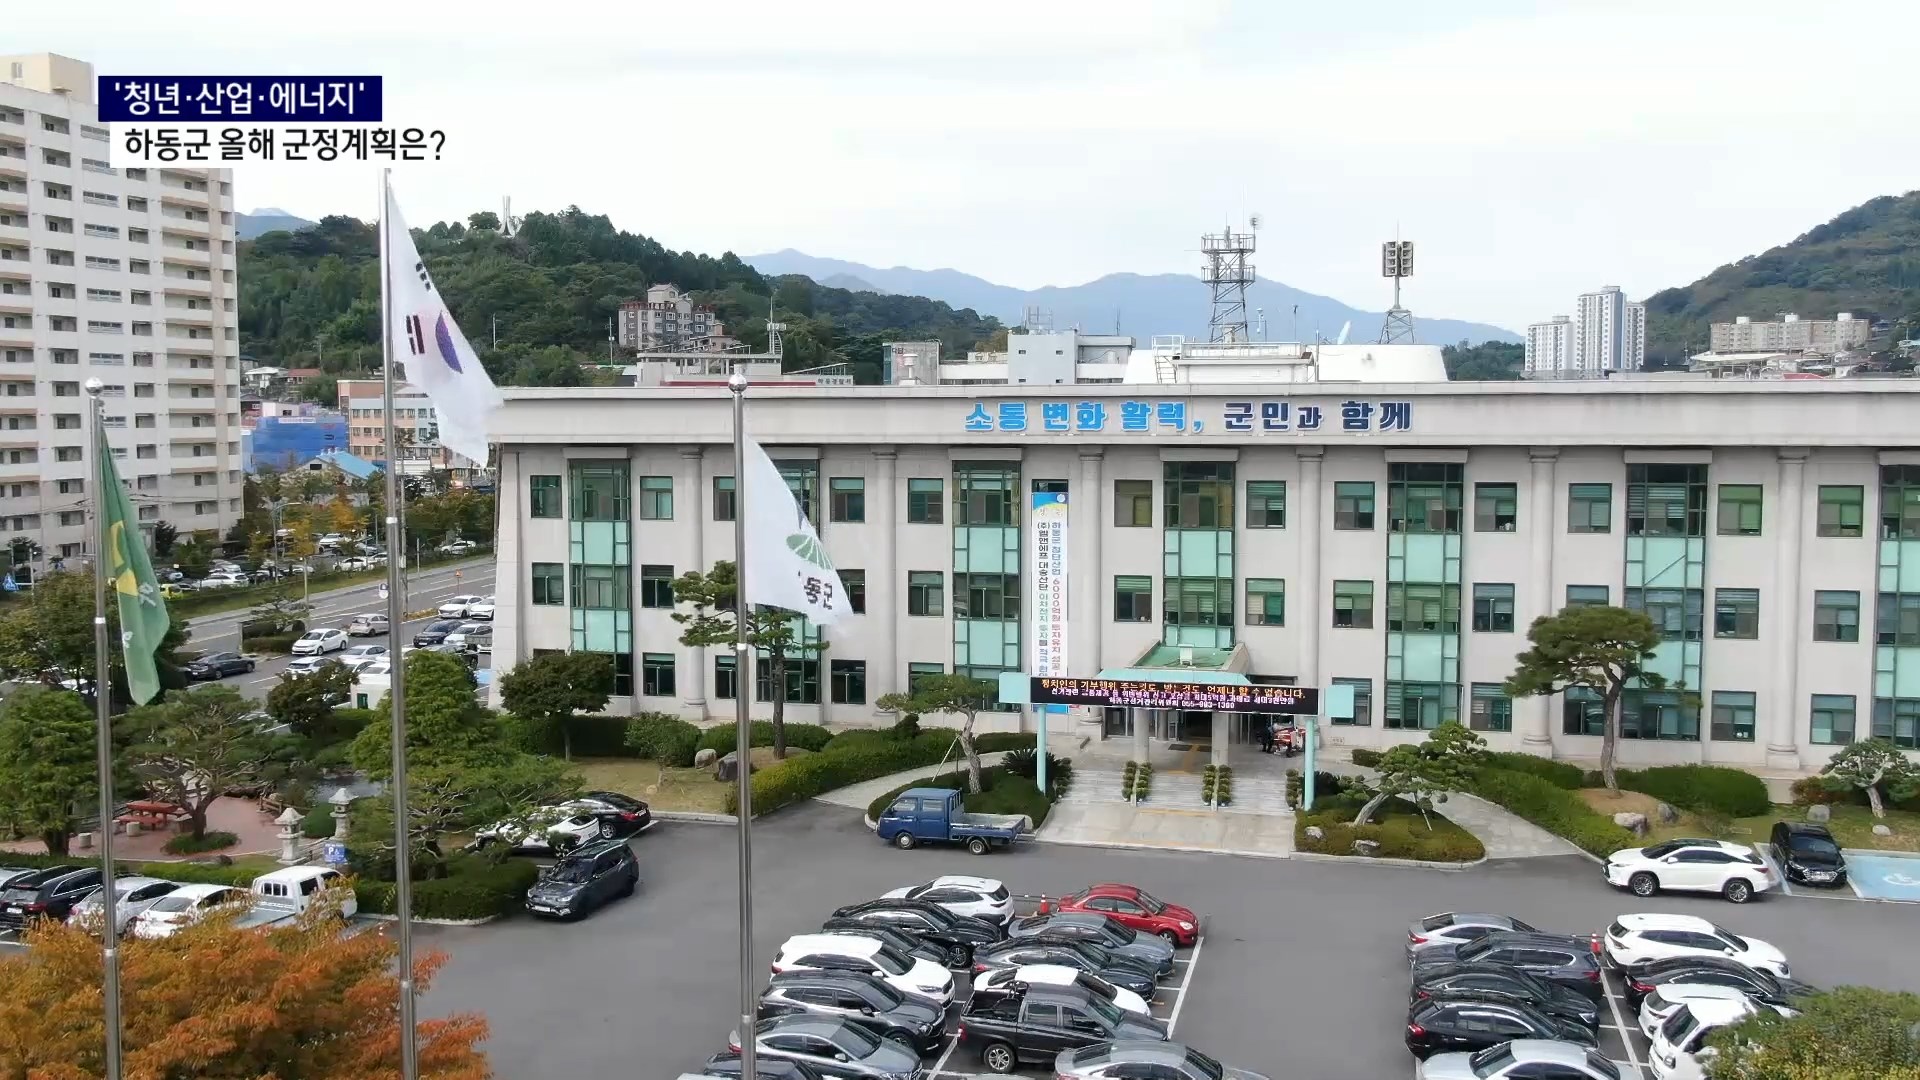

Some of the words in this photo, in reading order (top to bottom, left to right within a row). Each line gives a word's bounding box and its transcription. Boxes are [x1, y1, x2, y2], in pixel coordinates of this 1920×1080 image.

[965, 402, 1027, 431] 소통
[1041, 402, 1107, 431] 변화
[1120, 401, 1204, 433] 활력,
[1223, 402, 1323, 432] 군민과
[1341, 401, 1411, 431] 함께
[1051, 522, 1061, 544] 하동군
[1041, 679, 1077, 689] 정치인의
[1080, 680, 1116, 692] 기부행위
[1207, 685, 1235, 696] 언제나
[1264, 688, 1306, 699] 없습니다.
